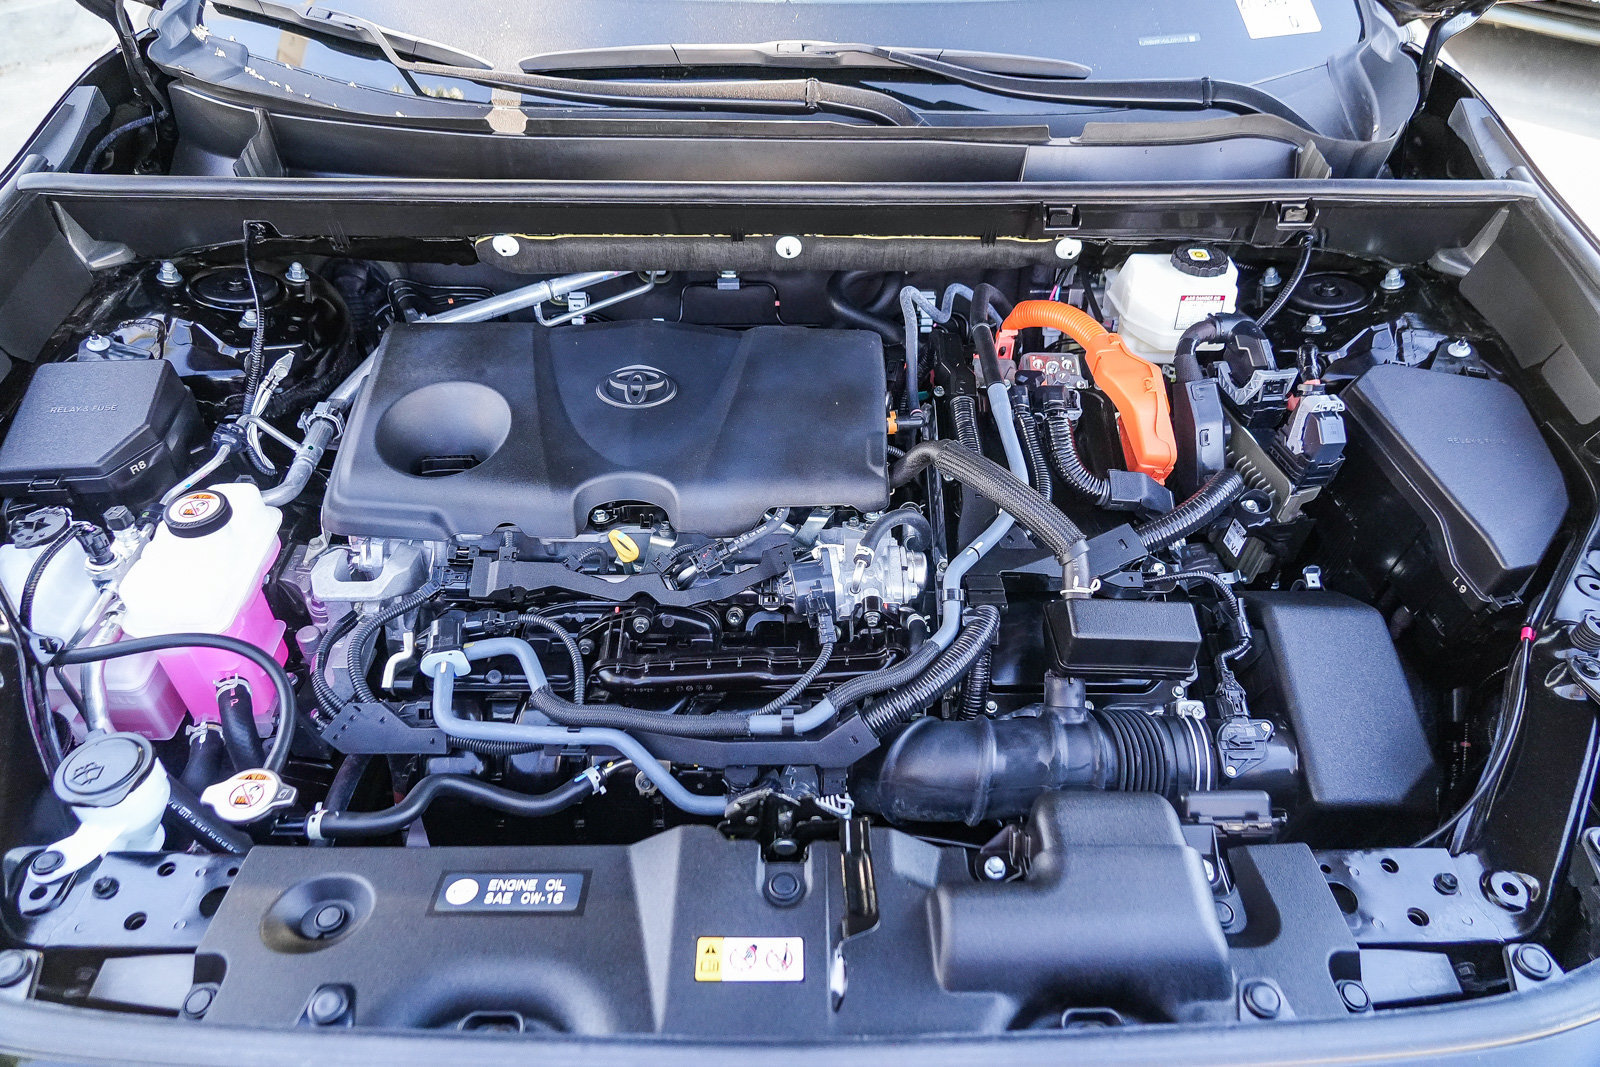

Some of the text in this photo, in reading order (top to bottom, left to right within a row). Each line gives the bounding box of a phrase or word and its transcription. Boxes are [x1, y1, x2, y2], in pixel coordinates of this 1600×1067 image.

[50, 406, 81, 414] RELAY
[91, 404, 119, 412] FUSE
[129, 460, 147, 475] R8
[487, 878, 567, 892] ENGINE OIL
[483, 891, 514, 905] SAE
